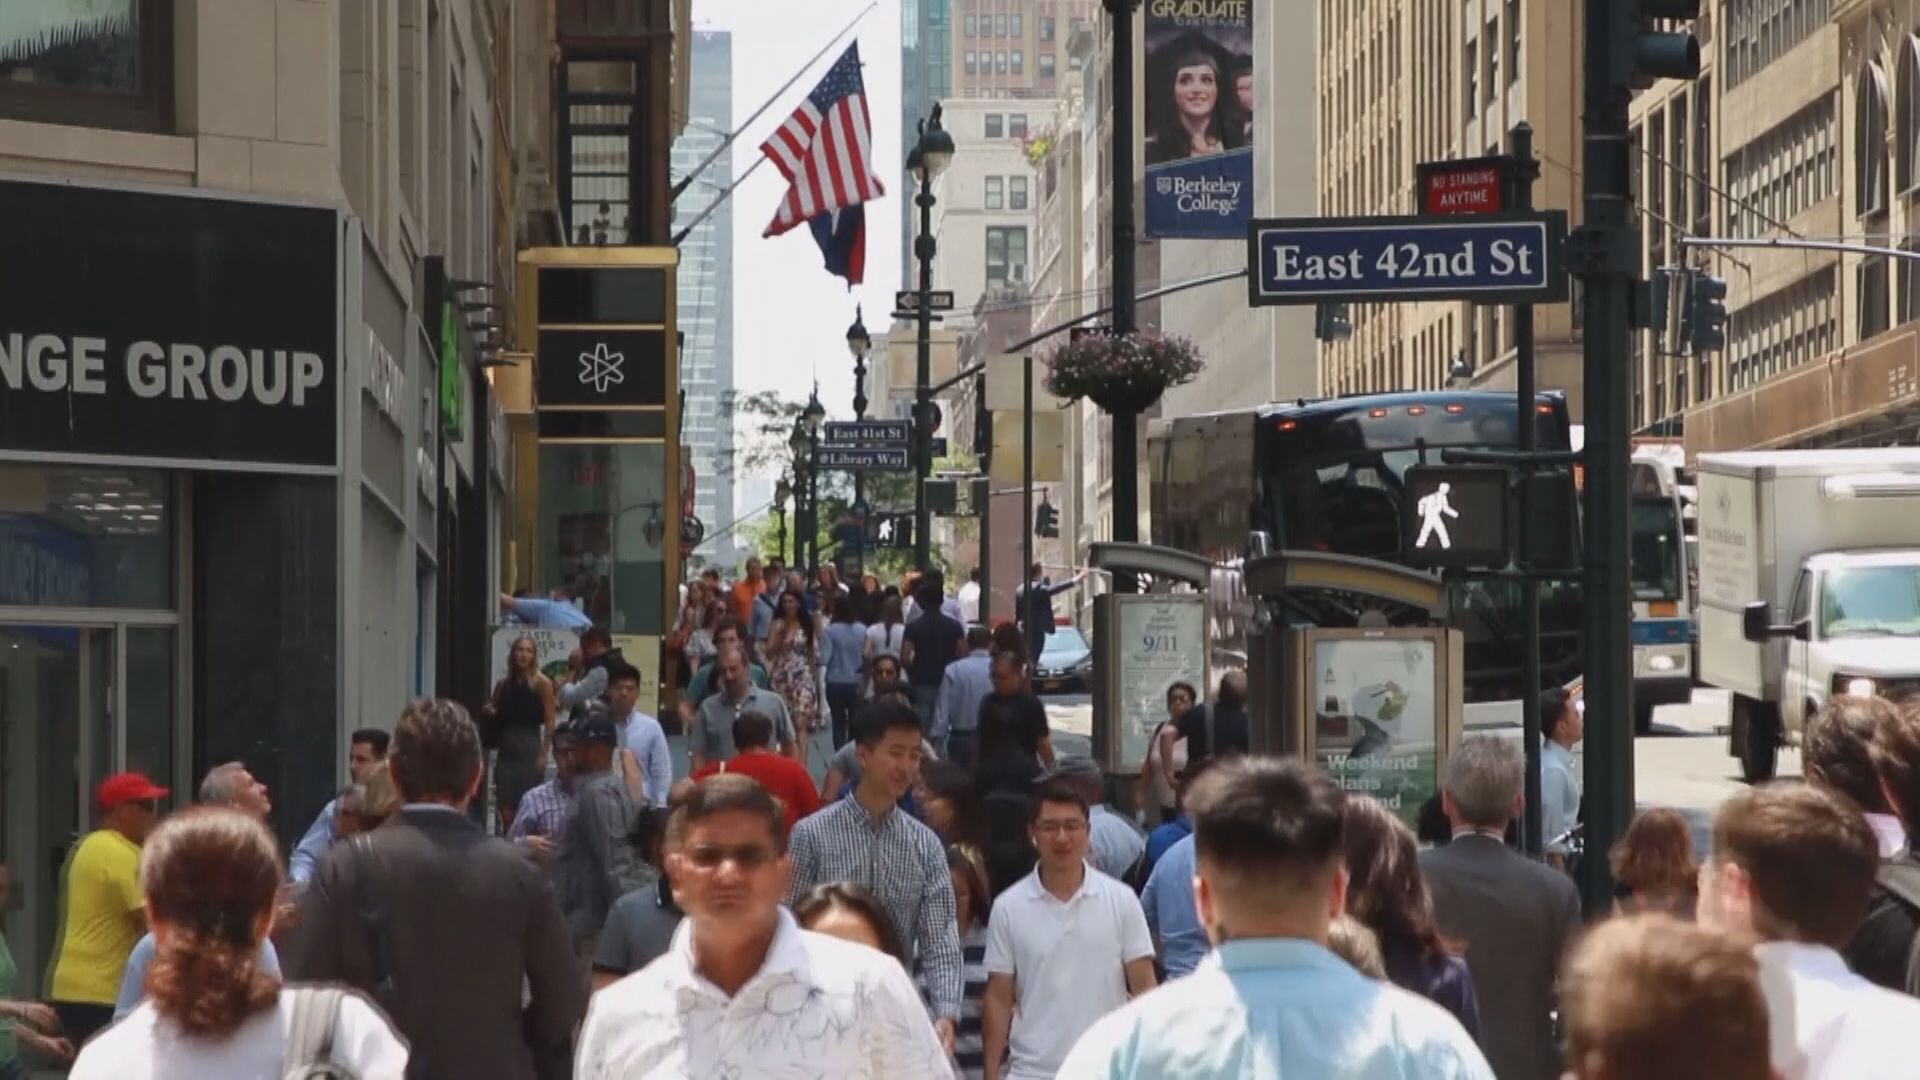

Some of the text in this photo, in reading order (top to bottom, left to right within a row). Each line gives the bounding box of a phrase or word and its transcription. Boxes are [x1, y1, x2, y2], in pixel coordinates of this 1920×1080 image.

[1151, 0, 1247, 18] GRADUATE
[1174, 176, 1241, 199] Berkeley
[1432, 169, 1496, 189] NO STANDING
[1177, 194, 1239, 216] College
[1440, 189, 1489, 207] ANYTIME
[1272, 238, 1533, 281] East 42nd St
[0, 333, 106, 394] NGE
[127, 340, 324, 406] GROUP
[833, 426, 901, 439] East 41st St
[876, 452, 904, 466] Way
[1143, 634, 1177, 653] 9/11
[1327, 754, 1418, 770] Weekend
